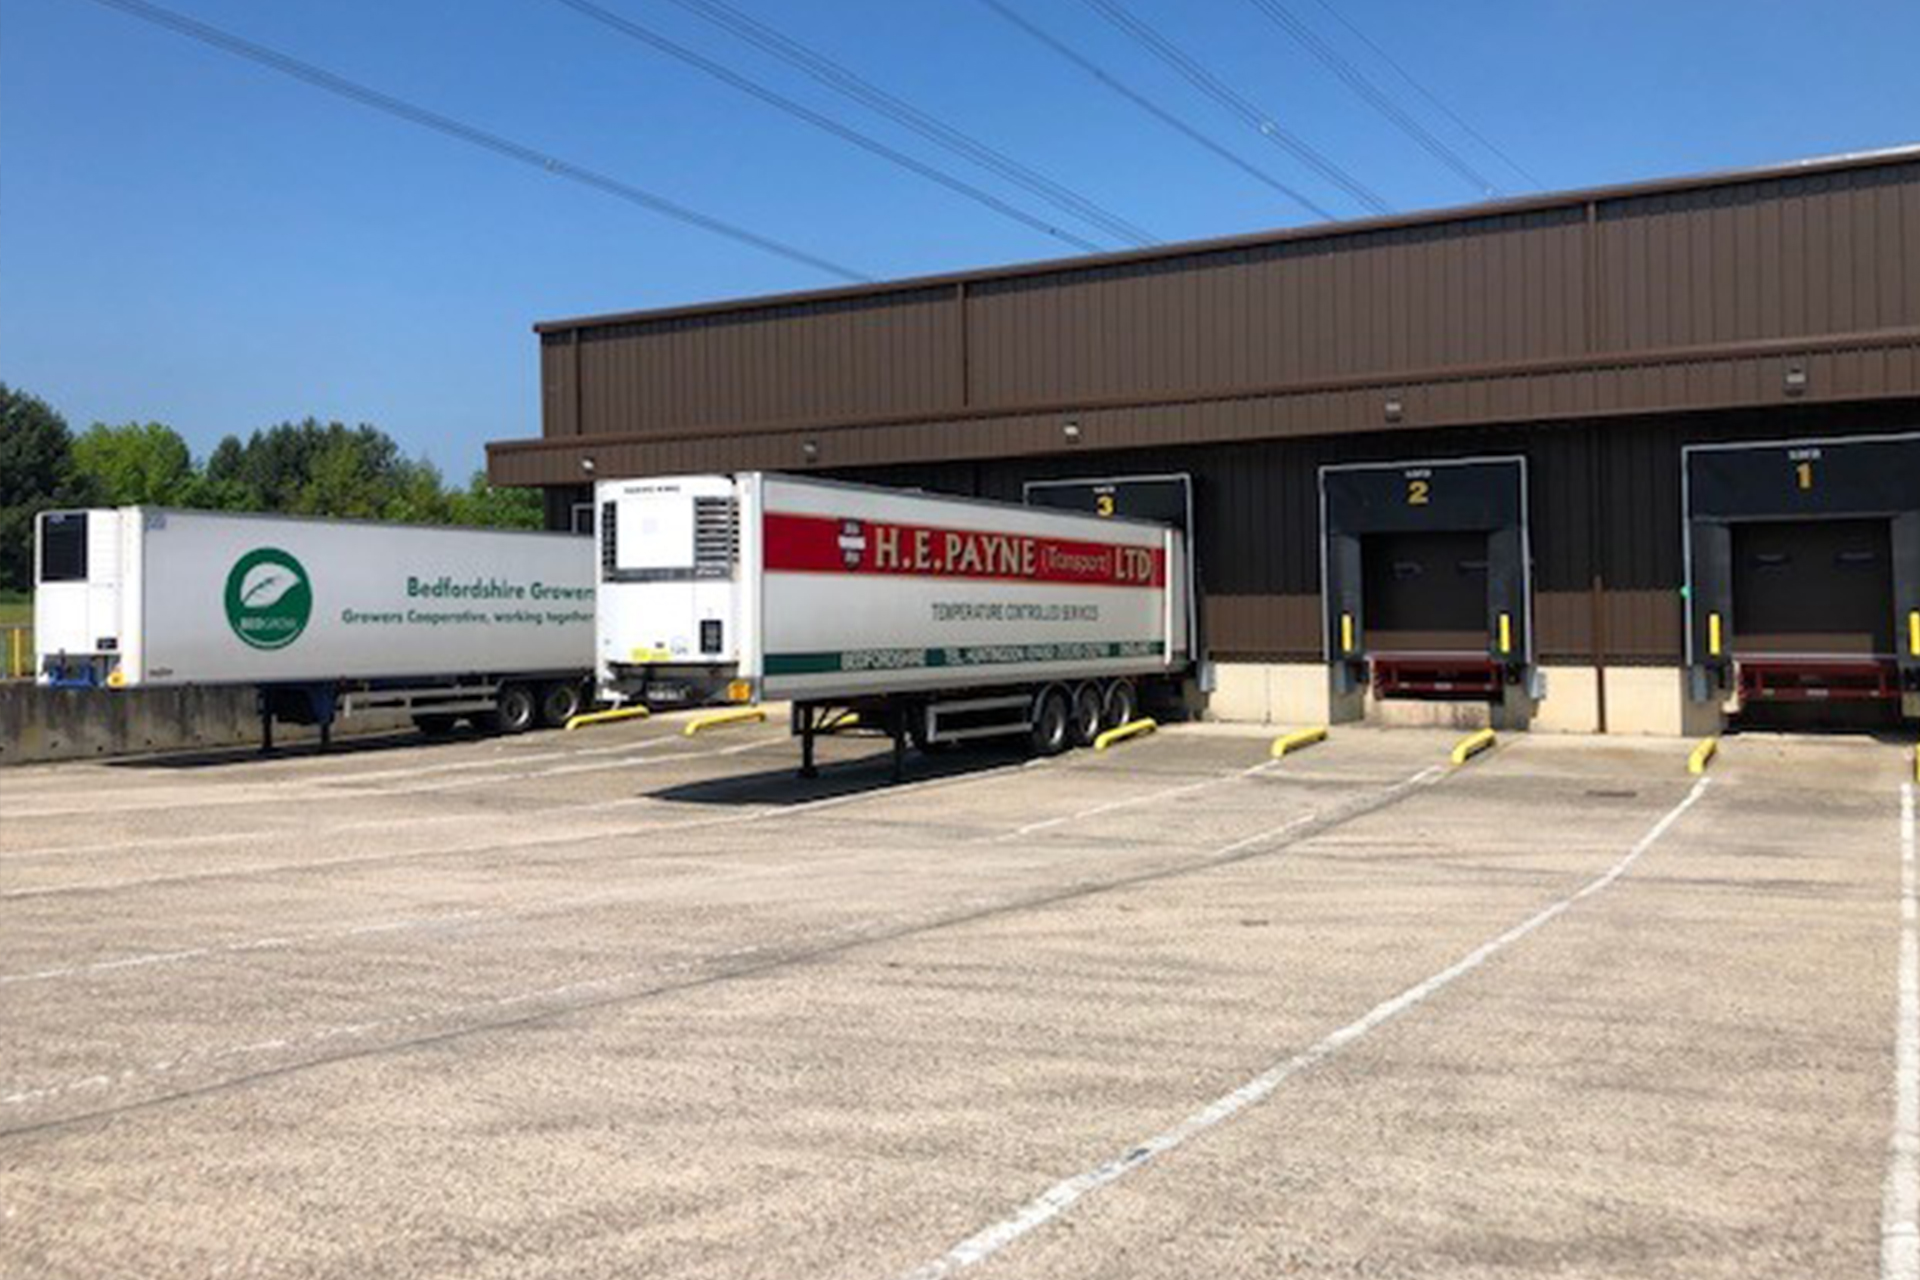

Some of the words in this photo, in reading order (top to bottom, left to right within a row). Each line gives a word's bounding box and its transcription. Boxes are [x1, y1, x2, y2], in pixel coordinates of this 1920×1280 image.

[1796, 462, 1811, 488] 1
[1408, 480, 1429, 504] 2
[1097, 495, 1114, 517] 3
[1114, 546, 1153, 581] LTD
[407, 576, 525, 599] Bedfordshire
[341, 608, 402, 624] Growers
[407, 609, 489, 626] Cooperative,
[493, 610, 542, 626] working
[546, 610, 595, 626] together
